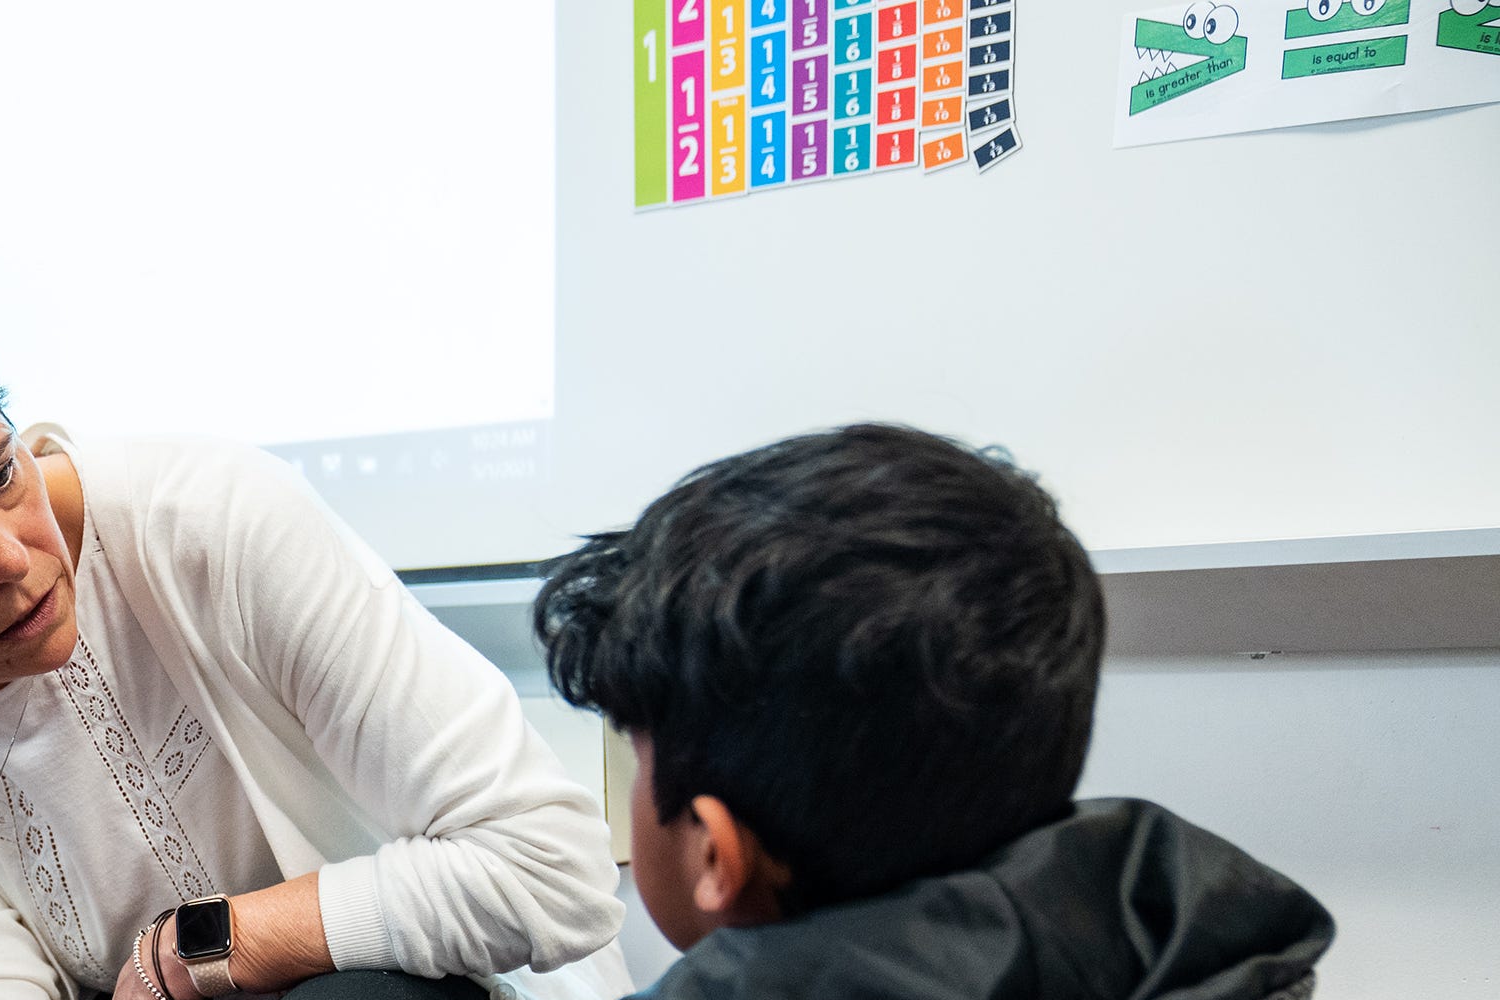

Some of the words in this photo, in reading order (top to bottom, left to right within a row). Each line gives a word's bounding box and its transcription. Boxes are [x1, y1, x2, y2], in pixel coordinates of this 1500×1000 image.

[722, 5, 733, 33] 1
[893, 8, 901, 20] 1
[803, 22, 818, 46] 5
[848, 17, 858, 38] 1
[892, 23, 902, 37] 8
[1480, 32, 1491, 43] is
[643, 29, 656, 83] 1
[762, 39, 773, 64] 1
[846, 41, 860, 62] 6
[893, 50, 900, 62] 1
[936, 41, 950, 53] 10
[1312, 54, 1322, 65] is
[1326, 47, 1359, 64] equal
[1364, 46, 1377, 58] to
[720, 46, 736, 76] 3
[805, 60, 816, 81] 1
[892, 64, 902, 79] 8
[761, 74, 776, 99] 4
[848, 72, 858, 94] 1
[936, 75, 950, 87] 10
[1145, 89, 1155, 99] is
[1158, 70, 1202, 96] greater
[1207, 58, 1234, 74] than
[681, 76, 695, 116] 1
[803, 89, 818, 112] 5
[845, 97, 860, 116] 6
[893, 91, 900, 104] 1
[891, 106, 901, 120] 8
[934, 109, 949, 121] 10
[722, 114, 733, 142] 1
[762, 118, 773, 144] 1
[804, 124, 815, 146] 1
[847, 127, 857, 147] 1
[892, 134, 899, 145] 1
[679, 135, 699, 177] 2
[802, 153, 817, 175] 5
[844, 151, 859, 171] 6
[890, 148, 901, 162] 8
[720, 155, 736, 184] 3
[761, 154, 775, 178] 4
